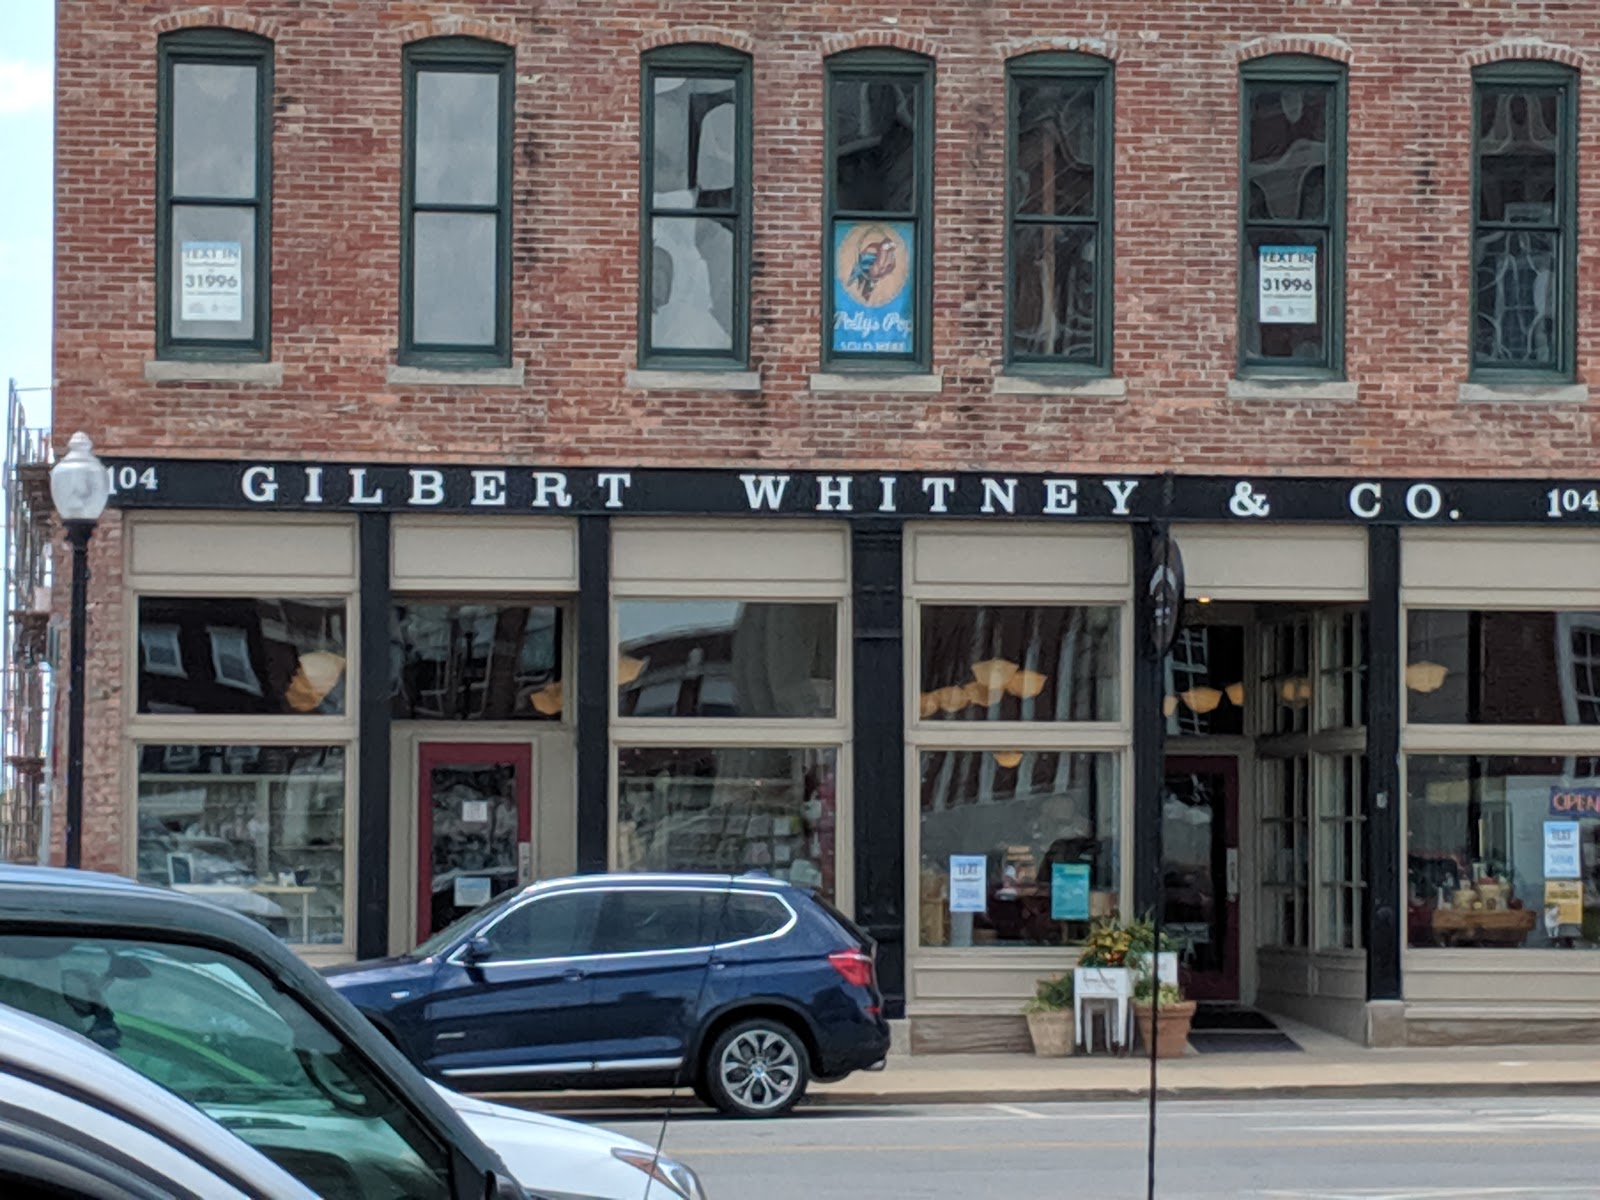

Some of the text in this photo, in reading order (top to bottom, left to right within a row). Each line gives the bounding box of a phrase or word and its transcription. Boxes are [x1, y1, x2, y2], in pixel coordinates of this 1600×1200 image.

[1263, 252, 1314, 263] TEXT IN
[185, 274, 238, 288] 31996
[1263, 278, 1313, 291] 31996
[107, 465, 158, 495] 104
[241, 466, 1462, 519] GILBERT WHITNEY & CO.
[1547, 488, 1599, 517] 104
[1553, 793, 1600, 814] OPEN
